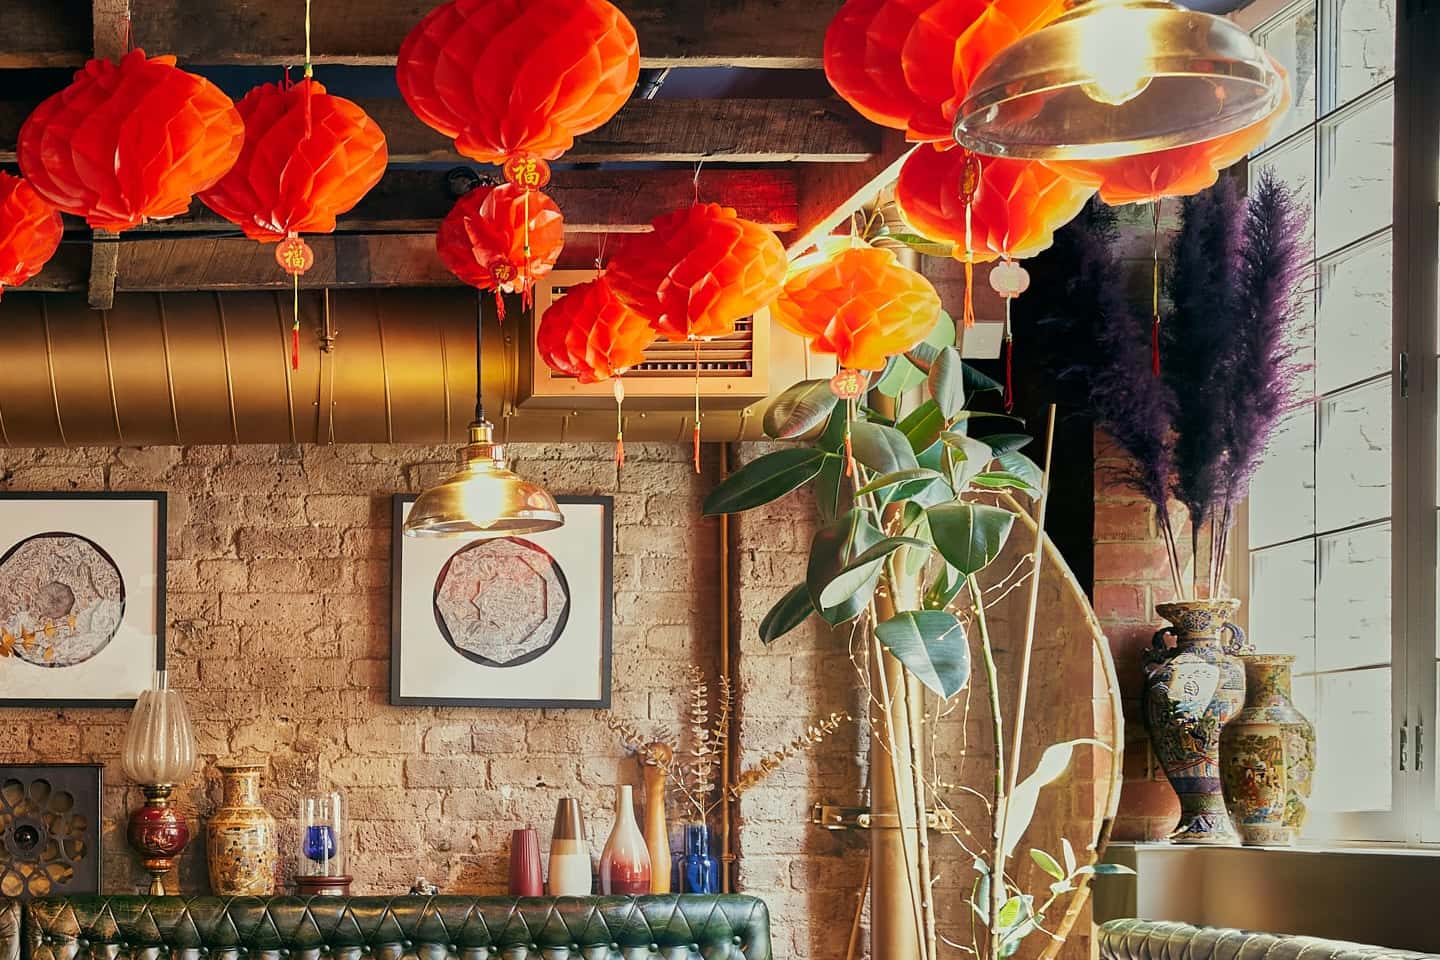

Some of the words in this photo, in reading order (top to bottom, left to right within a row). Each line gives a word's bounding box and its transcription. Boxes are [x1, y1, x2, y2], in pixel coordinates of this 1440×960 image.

[512, 158, 540, 186] 福
[283, 244, 305, 269] 福
[837, 374, 858, 395] 福
